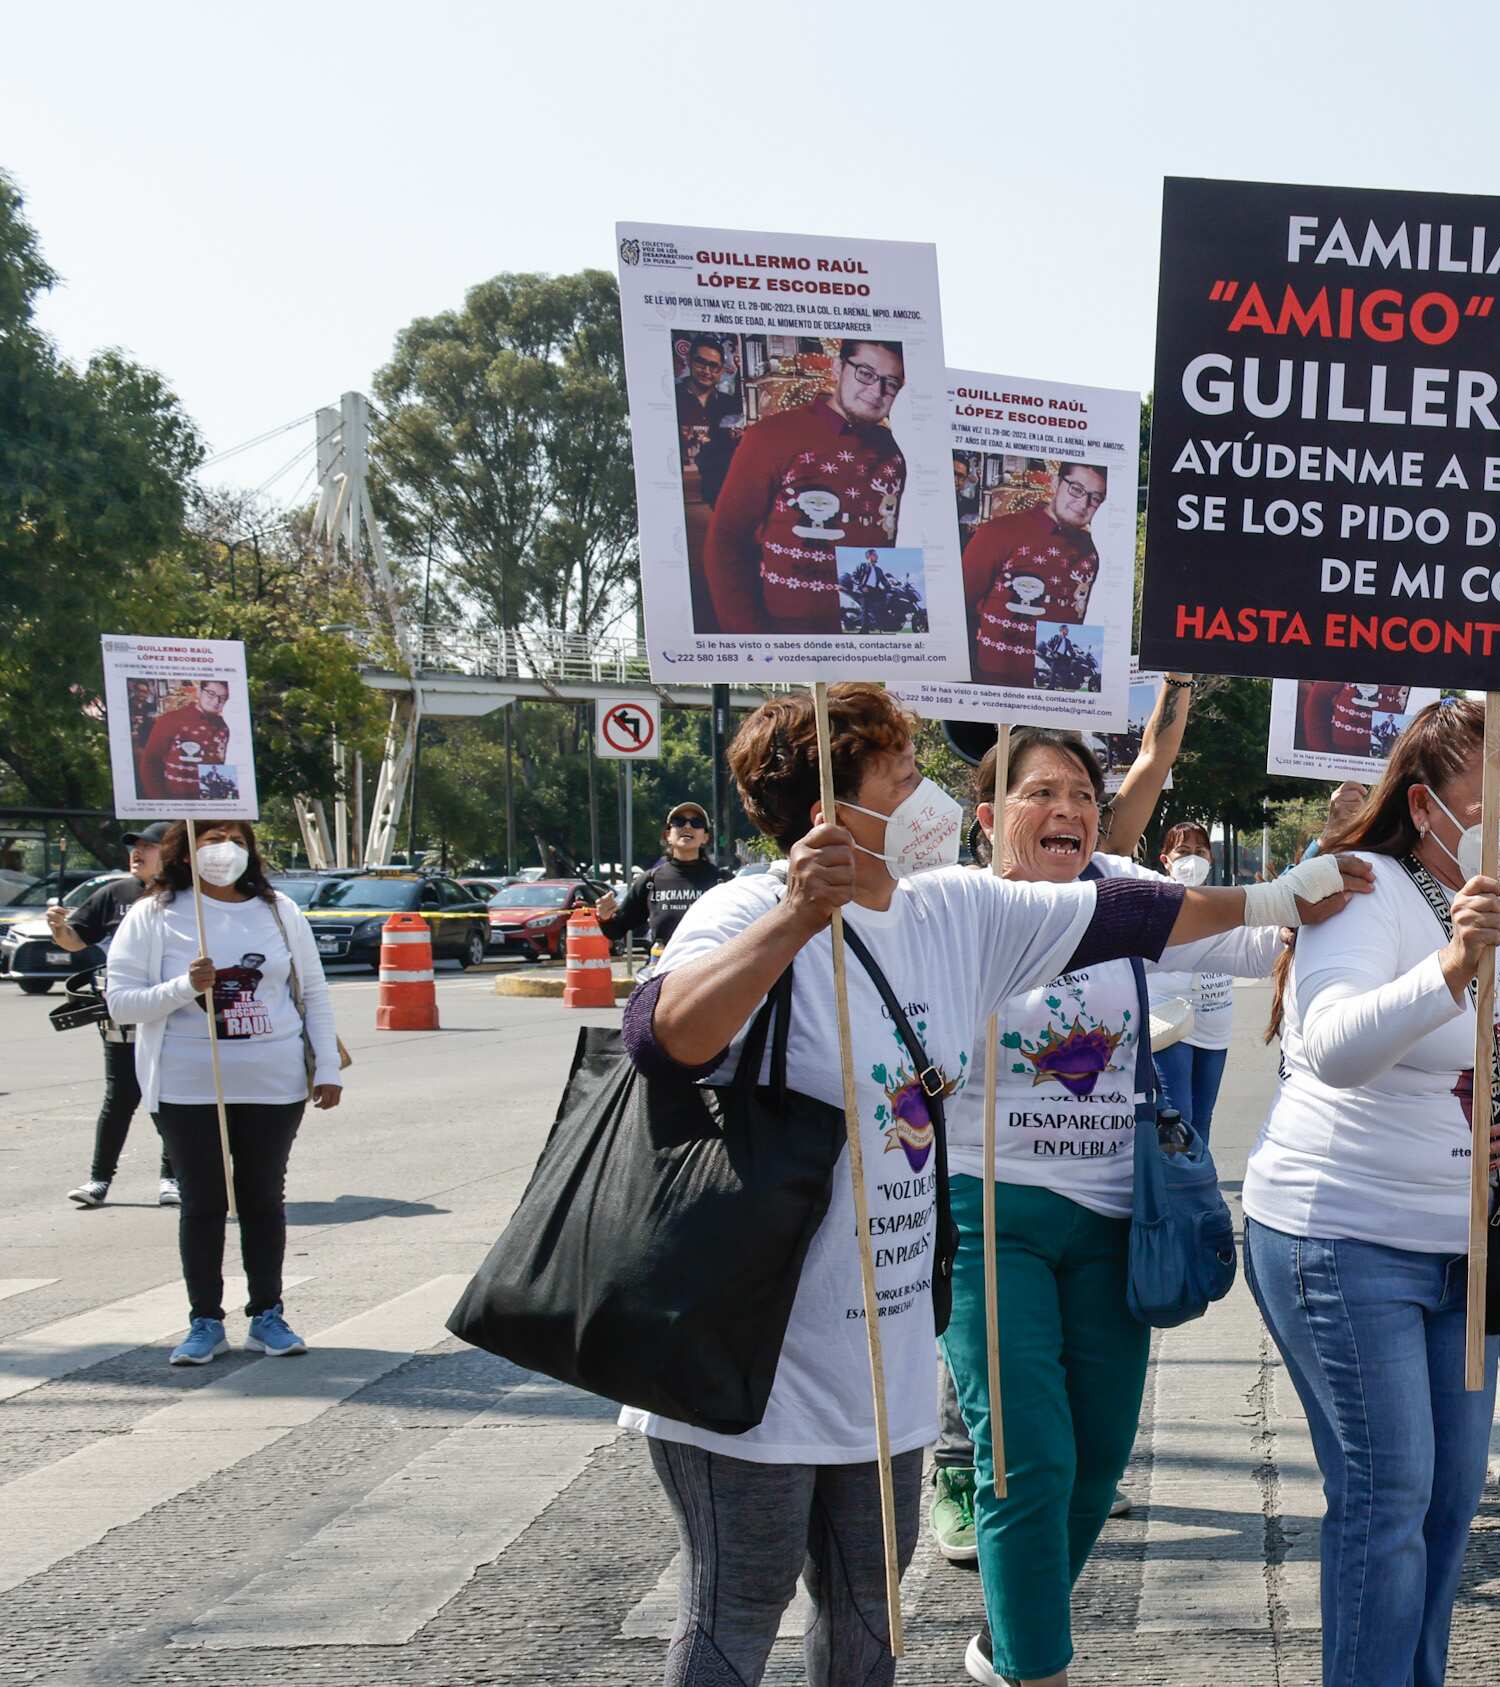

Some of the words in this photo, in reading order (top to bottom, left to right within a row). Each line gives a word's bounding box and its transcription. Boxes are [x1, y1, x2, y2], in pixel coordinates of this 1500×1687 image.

[696, 251, 810, 269] GUILLERMO
[817, 256, 867, 273] RAÚL
[696, 271, 760, 289] LÓPEZ
[766, 278, 869, 295] ESCOBEDO
[644, 295, 653, 304] SE
[654, 296, 663, 305] LE
[678, 297, 691, 306] POR
[721, 300, 734, 309] VEZ
[738, 300, 745, 309] EL
[796, 304, 804, 313] EN
[807, 304, 815, 313] LA
[833, 306, 841, 315] EL
[701, 314, 710, 323] 27
[734, 316, 742, 325] DE
[767, 318, 775, 326] AL
[777, 318, 811, 328] MOMENTO
[813, 320, 822, 329] DE
[823, 321, 871, 331] DESAPARECER
[957, 387, 1043, 407] GUILLERMO
[955, 403, 1003, 420] LÓPEZ
[1008, 411, 1087, 429] ESCOBEDO
[1172, 432, 1424, 486] AYÚDENME
[1436, 454, 1469, 489] A
[1178, 495, 1226, 530] SE
[1243, 499, 1323, 537] LOS
[1341, 504, 1449, 544] PIDO
[1321, 558, 1377, 594] DE
[1391, 562, 1444, 599] MI
[1177, 605, 1310, 644] HASTA
[696, 640, 704, 648] Si
[708, 640, 716, 648] le
[719, 640, 735, 648] has
[738, 640, 761, 648] visto
[1034, 1140, 1056, 1155] EN
[876, 1249, 894, 1268] EN
